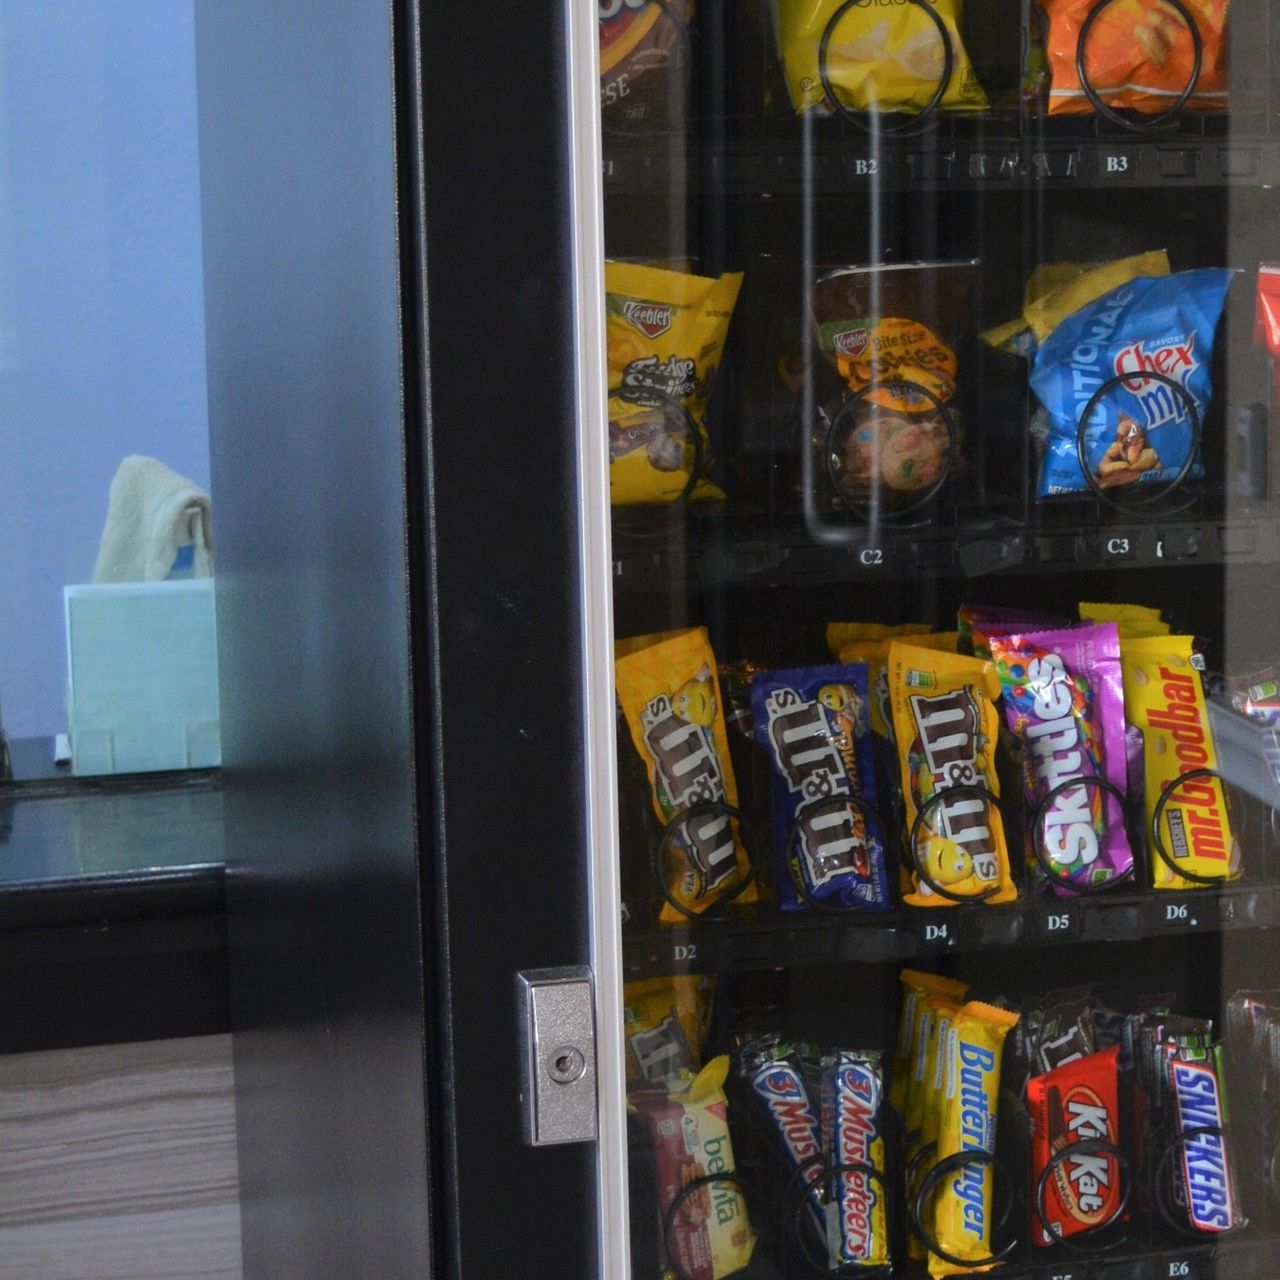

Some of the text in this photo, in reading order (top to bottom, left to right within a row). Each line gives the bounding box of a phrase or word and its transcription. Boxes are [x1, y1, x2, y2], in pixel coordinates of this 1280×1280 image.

[856, 159, 877, 175] B2
[1107, 156, 1128, 172] B3
[624, 302, 670, 326] Keebler
[1149, 335, 1184, 346] SAVORY
[1116, 336, 1195, 391] Chex
[1107, 538, 1130, 554] C3
[860, 549, 883, 565] C2
[1027, 654, 1098, 865] Skittles
[1166, 904, 1188, 920] D6
[1047, 914, 1069, 930] D5
[926, 925, 947, 940] D4
[674, 945, 696, 961] D2
[766, 1075, 791, 1095] 3
[1174, 1067, 1230, 1230] SNICKERS
[837, 1068, 877, 1259] 3 Musketeers
[1070, 1154, 1109, 1214] Kat
[1169, 1262, 1189, 1276] E6
